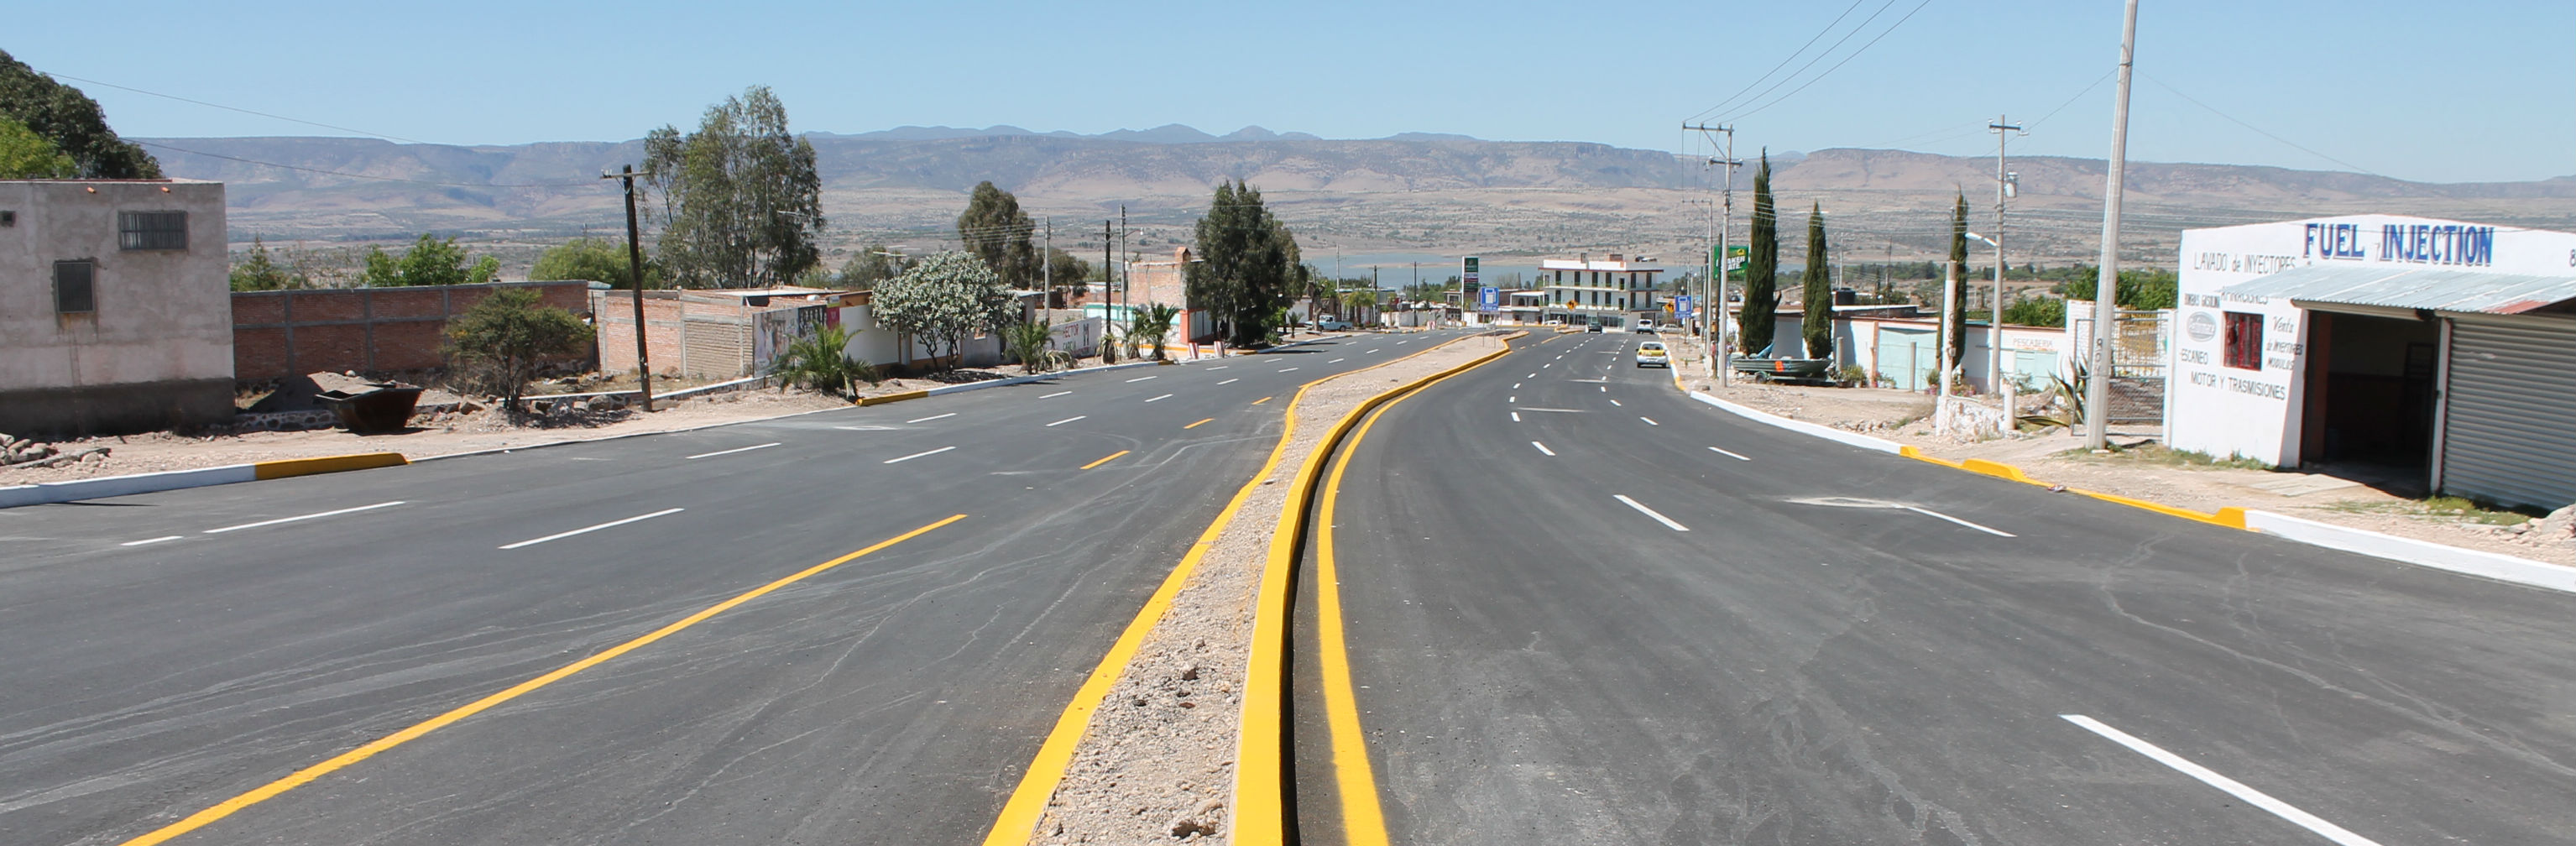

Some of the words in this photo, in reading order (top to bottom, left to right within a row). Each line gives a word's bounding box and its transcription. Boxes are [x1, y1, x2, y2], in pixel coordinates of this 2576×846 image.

[2303, 223, 2364, 259] FUEL
[2379, 224, 2495, 267] INJECTION
[2193, 252, 2228, 272] LAVADO
[2232, 253, 2241, 273] de
[2244, 254, 2296, 274] INYECTORES
[2272, 316, 2295, 333] Venta
[2191, 371, 2217, 389] MOTOR
[2219, 375, 2225, 389] Y
[2229, 377, 2286, 400] TRASMISIONES
